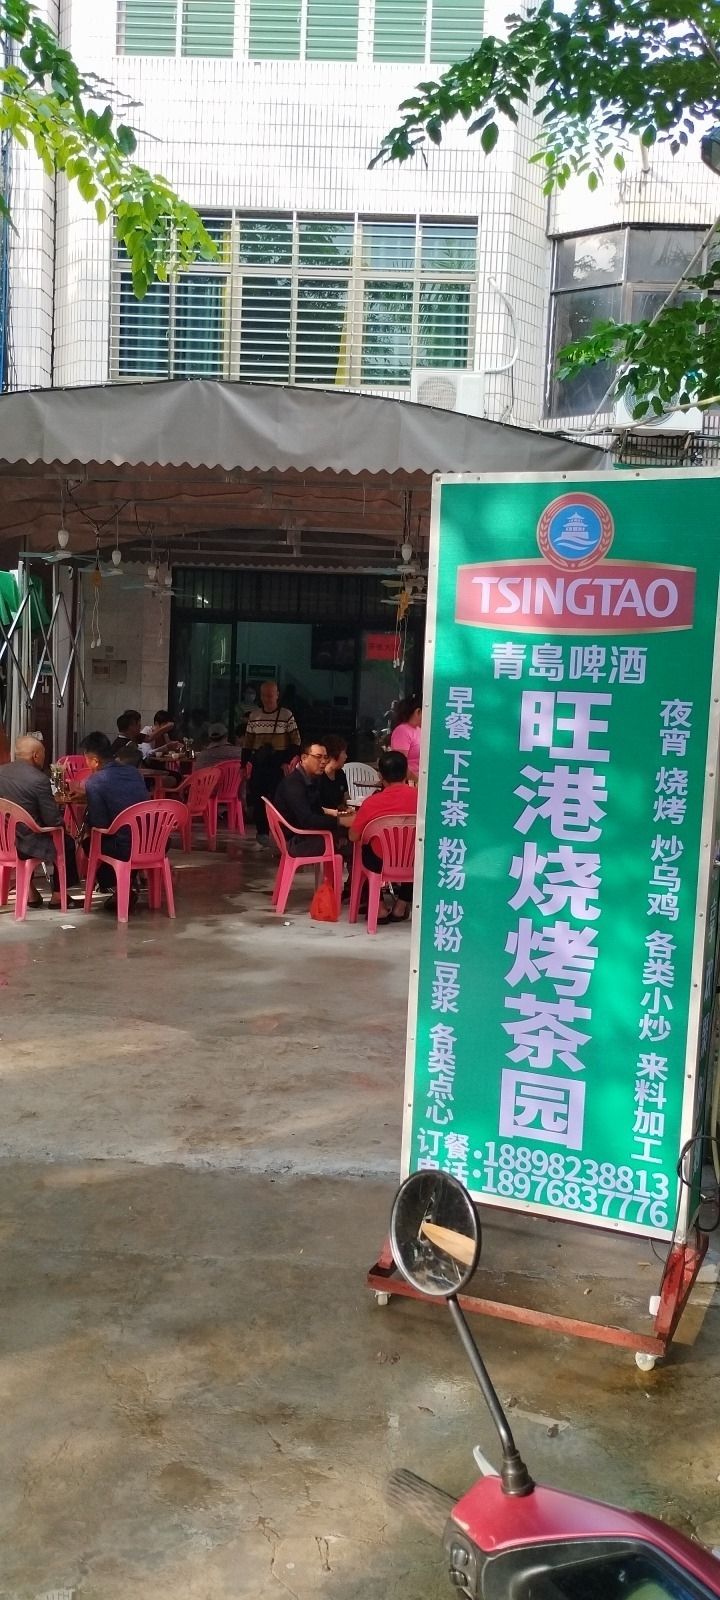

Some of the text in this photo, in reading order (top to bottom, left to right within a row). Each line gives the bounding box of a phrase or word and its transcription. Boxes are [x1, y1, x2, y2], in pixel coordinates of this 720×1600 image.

[472, 576, 679, 618] TSINGTAO
[490, 641, 649, 685] 青島啤酒
[425, 686, 474, 1125] 早餐 下午茶 粉汤 炒粉 豆浆 各类点心
[494, 690, 613, 1152] 旺港烧烤茶园
[631, 699, 693, 1164] 夜宵 烧烤 炒乌鸡 各类小炒 来料加工
[417, 1127, 669, 1201] 订餐 18898238813
[482, 1166, 669, 1228] 18976837776
